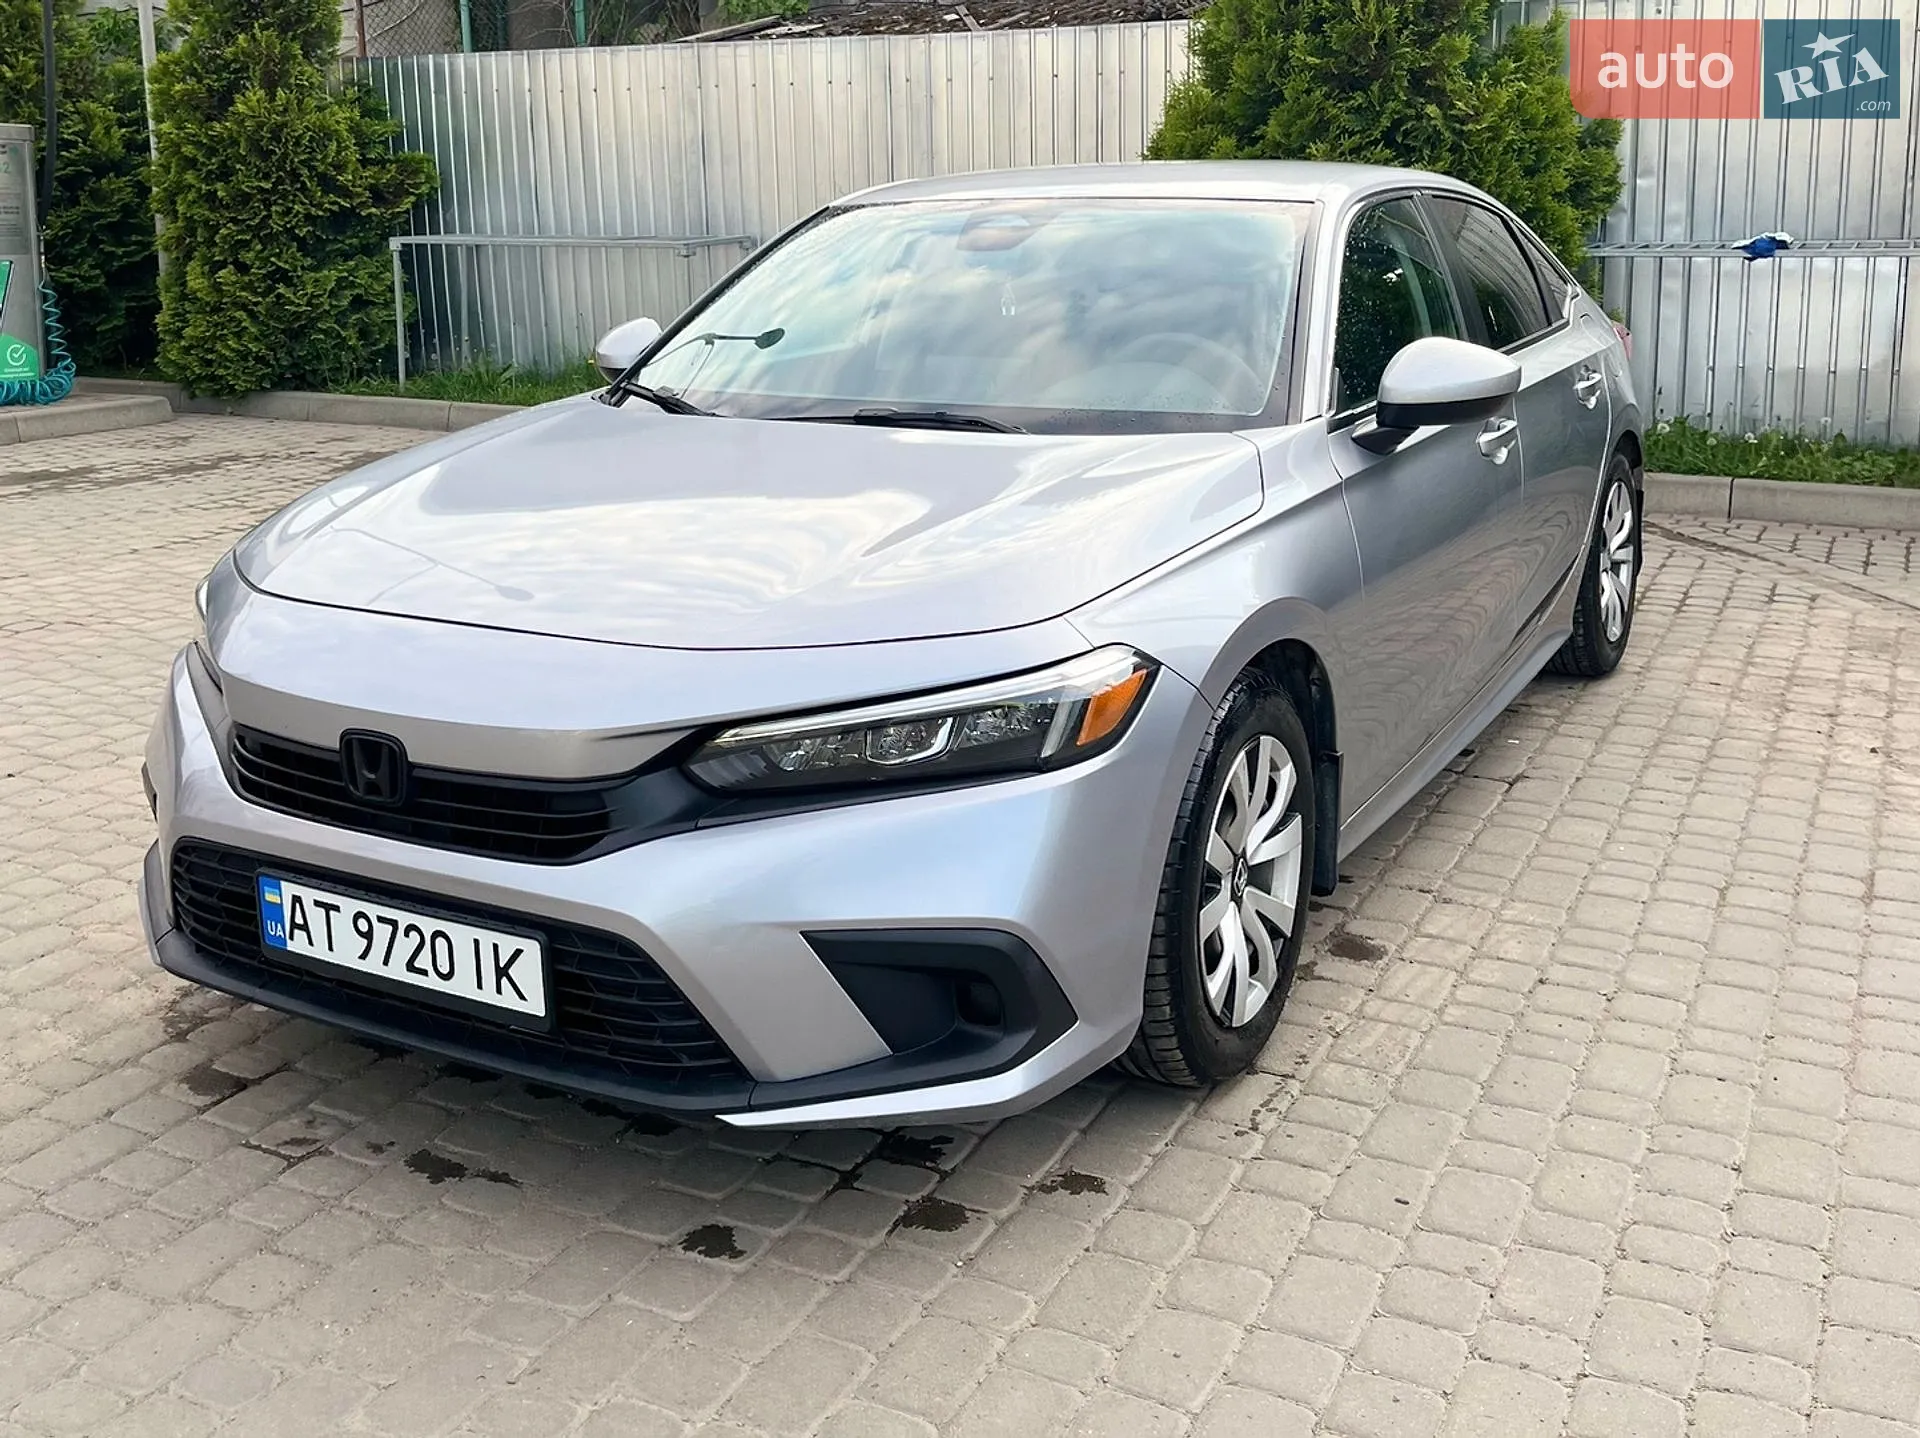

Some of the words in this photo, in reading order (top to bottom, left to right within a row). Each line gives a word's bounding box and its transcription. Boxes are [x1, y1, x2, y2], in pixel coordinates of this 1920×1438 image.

[267, 920, 285, 938] UA
[288, 894, 341, 952] AT
[352, 910, 455, 981] 9720
[473, 938, 528, 1002] IK
